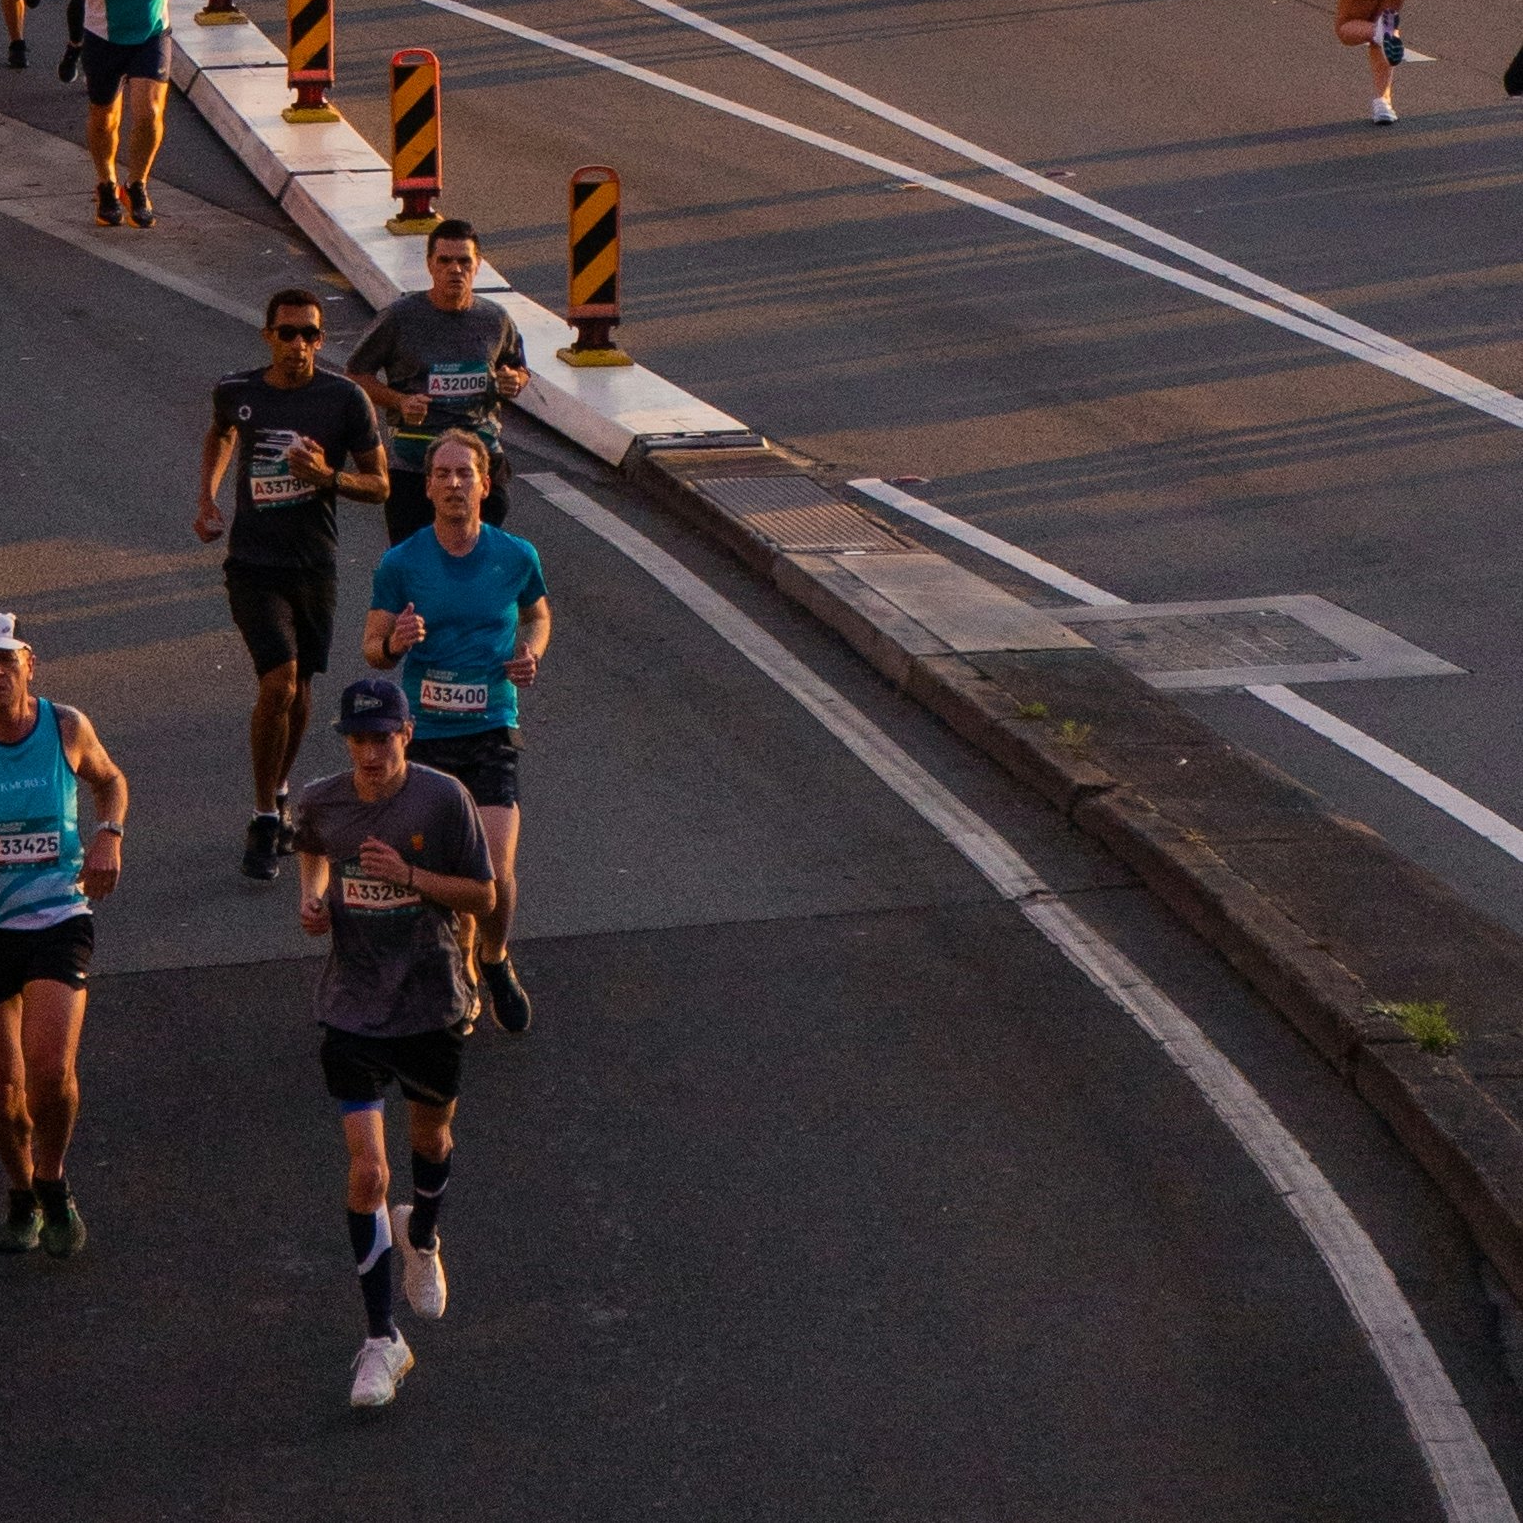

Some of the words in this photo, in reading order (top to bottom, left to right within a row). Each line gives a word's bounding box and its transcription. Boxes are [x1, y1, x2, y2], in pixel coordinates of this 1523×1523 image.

[431, 375, 486, 391] A32006
[422, 685, 486, 705] A33400
[0, 836, 58, 855] 33425
